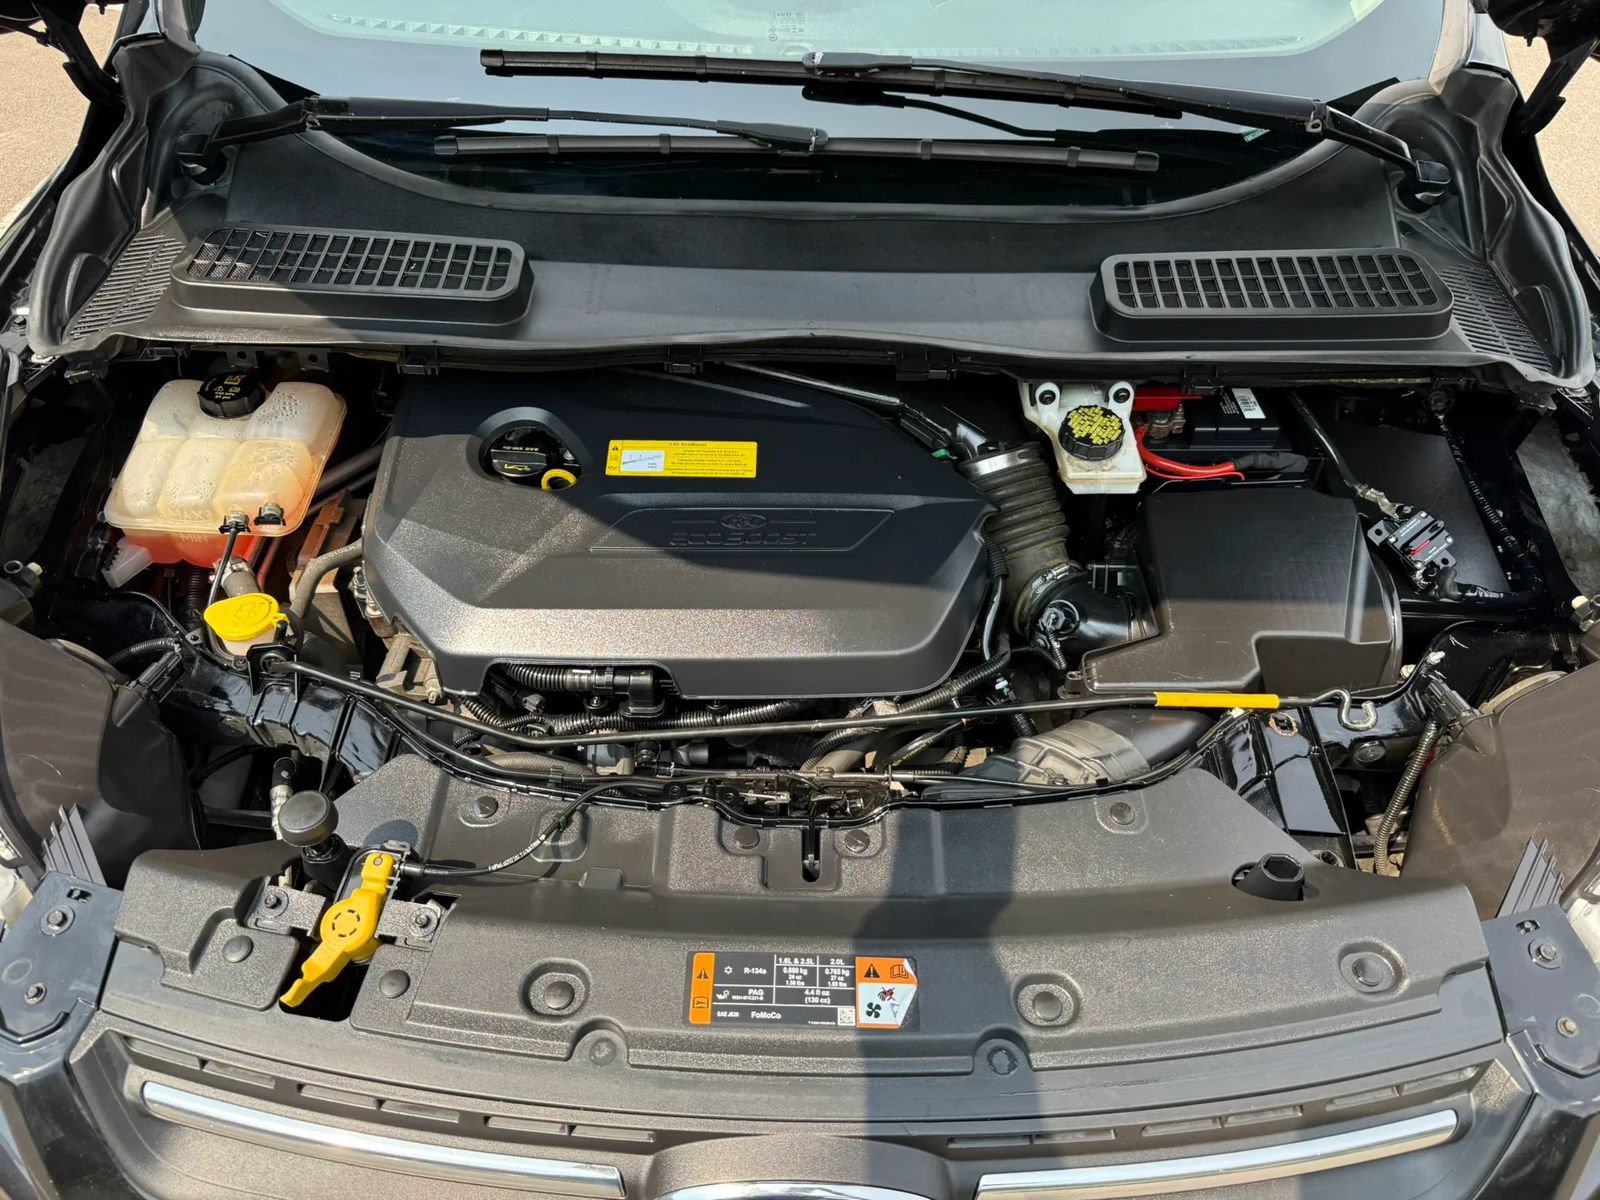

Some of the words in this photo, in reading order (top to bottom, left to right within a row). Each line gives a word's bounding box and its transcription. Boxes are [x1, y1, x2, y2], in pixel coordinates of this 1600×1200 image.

[778, 957, 794, 965] 1.6L
[799, 967, 808, 975] kg
[841, 968, 850, 977] kg
[804, 996, 819, 1004] (130
[751, 1011, 782, 1019] FoMoCo
